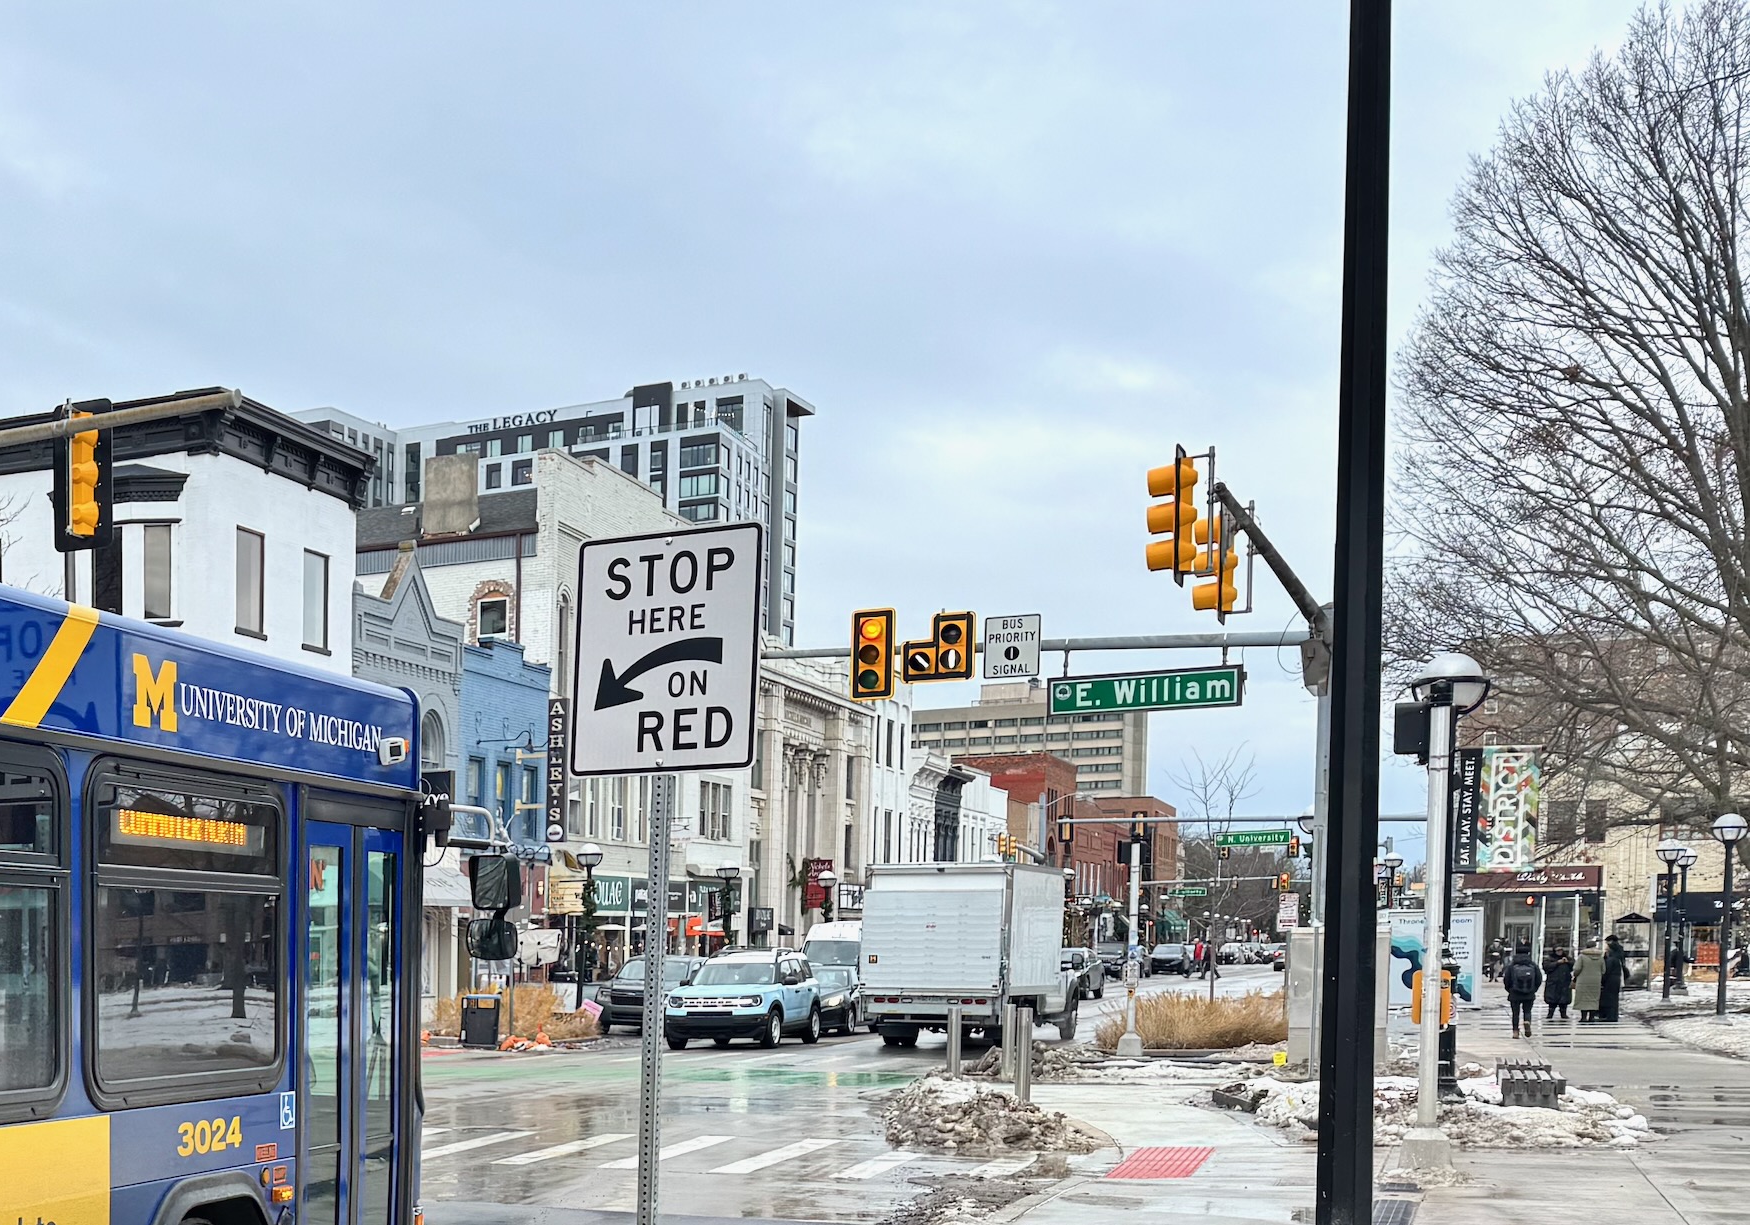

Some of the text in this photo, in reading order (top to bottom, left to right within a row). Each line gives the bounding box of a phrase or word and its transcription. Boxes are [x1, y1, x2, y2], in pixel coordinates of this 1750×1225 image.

[467, 409, 558, 433] THE LEGACY
[605, 547, 735, 600] STOP
[628, 603, 706, 636] HERE
[1002, 618, 1024, 630] BUS
[988, 631, 1036, 644] PRIORITY
[668, 669, 708, 698] ON
[992, 663, 1031, 675] SIGNAL
[132, 652, 382, 752] M UNIVERSITY OF MICHIGAN
[1075, 676, 1231, 708] E. William
[637, 706, 733, 753] RED
[549, 701, 565, 821] ASHLEY'S
[1460, 757, 1475, 865] EAT. PLAY. STAY. MEET.
[1494, 759, 1519, 864] DISTRICT
[1239, 834, 1285, 843] University
[590, 880, 623, 906] OUAC
[177, 1115, 243, 1157] 3024
